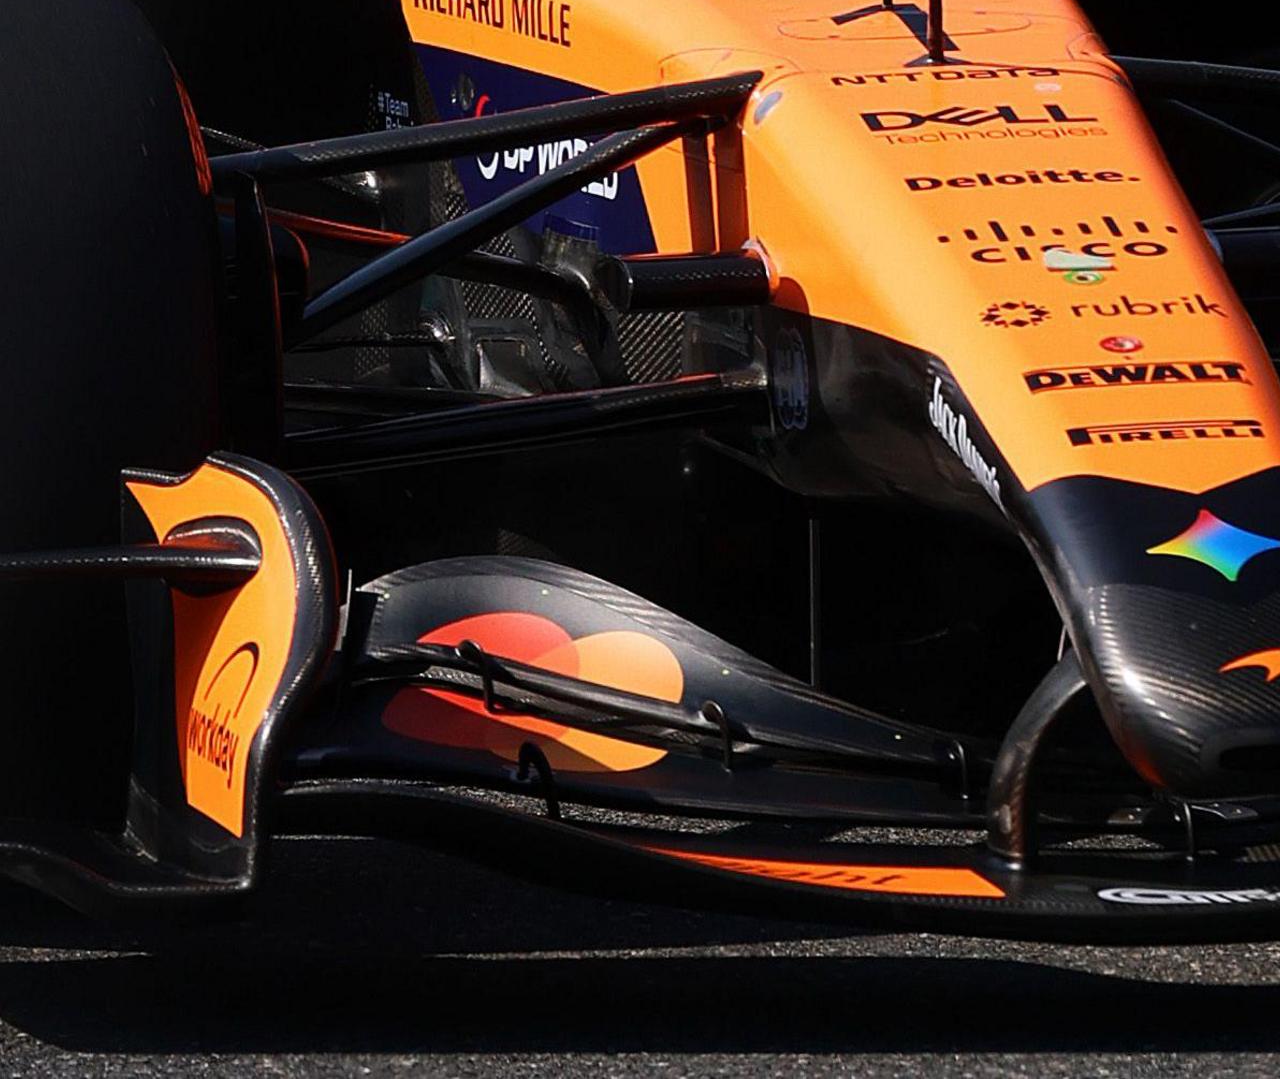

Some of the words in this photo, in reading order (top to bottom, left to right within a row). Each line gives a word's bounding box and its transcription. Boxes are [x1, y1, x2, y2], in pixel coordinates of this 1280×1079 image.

[830, 72, 924, 87] NTT
[860, 104, 1099, 132] DELL
[874, 125, 1109, 146] Technologies
[904, 168, 1141, 192] Deloitte.
[1071, 294, 1228, 319] rubrik
[1066, 420, 1265, 446] PIRELLI
[188, 703, 240, 790] workday
